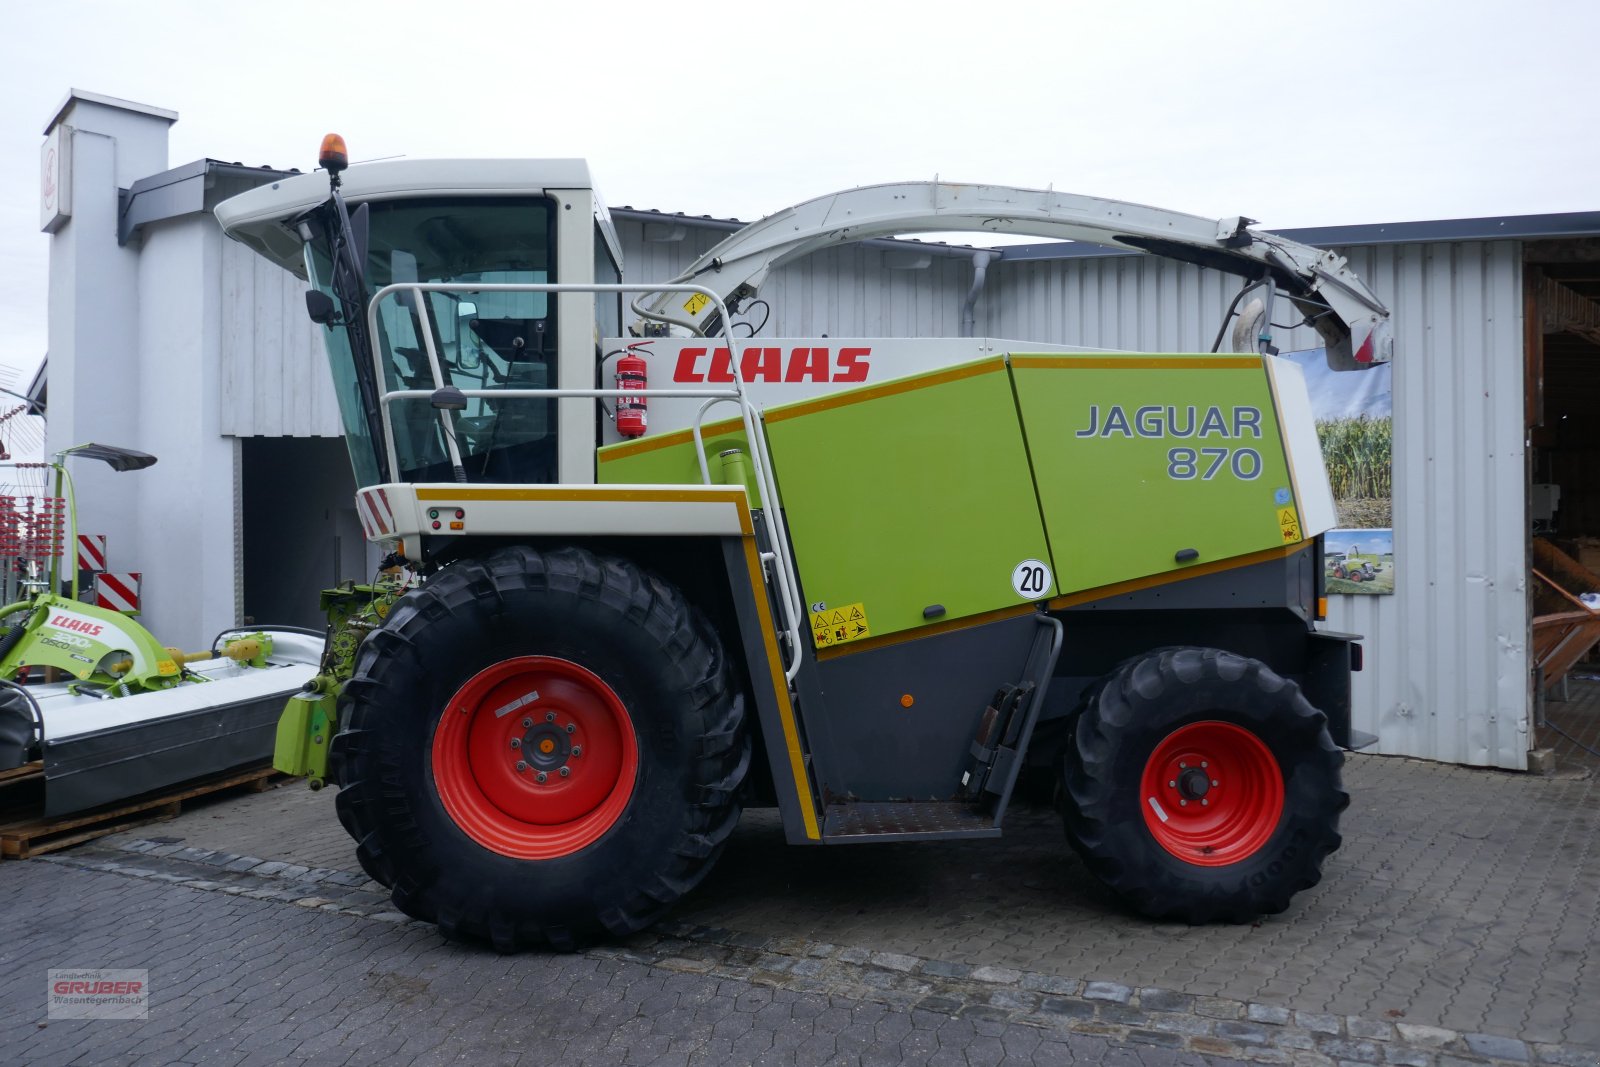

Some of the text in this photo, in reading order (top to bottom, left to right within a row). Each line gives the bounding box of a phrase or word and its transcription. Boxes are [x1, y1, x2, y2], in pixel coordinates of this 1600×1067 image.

[673, 347, 872, 383] CLAAS
[1075, 404, 1263, 438] JAGUAR
[1167, 447, 1263, 481] 870
[1020, 566, 1044, 593] 20
[812, 602, 825, 613] CE
[51, 615, 104, 636] CLAAS
[40, 637, 71, 650] DISCO
